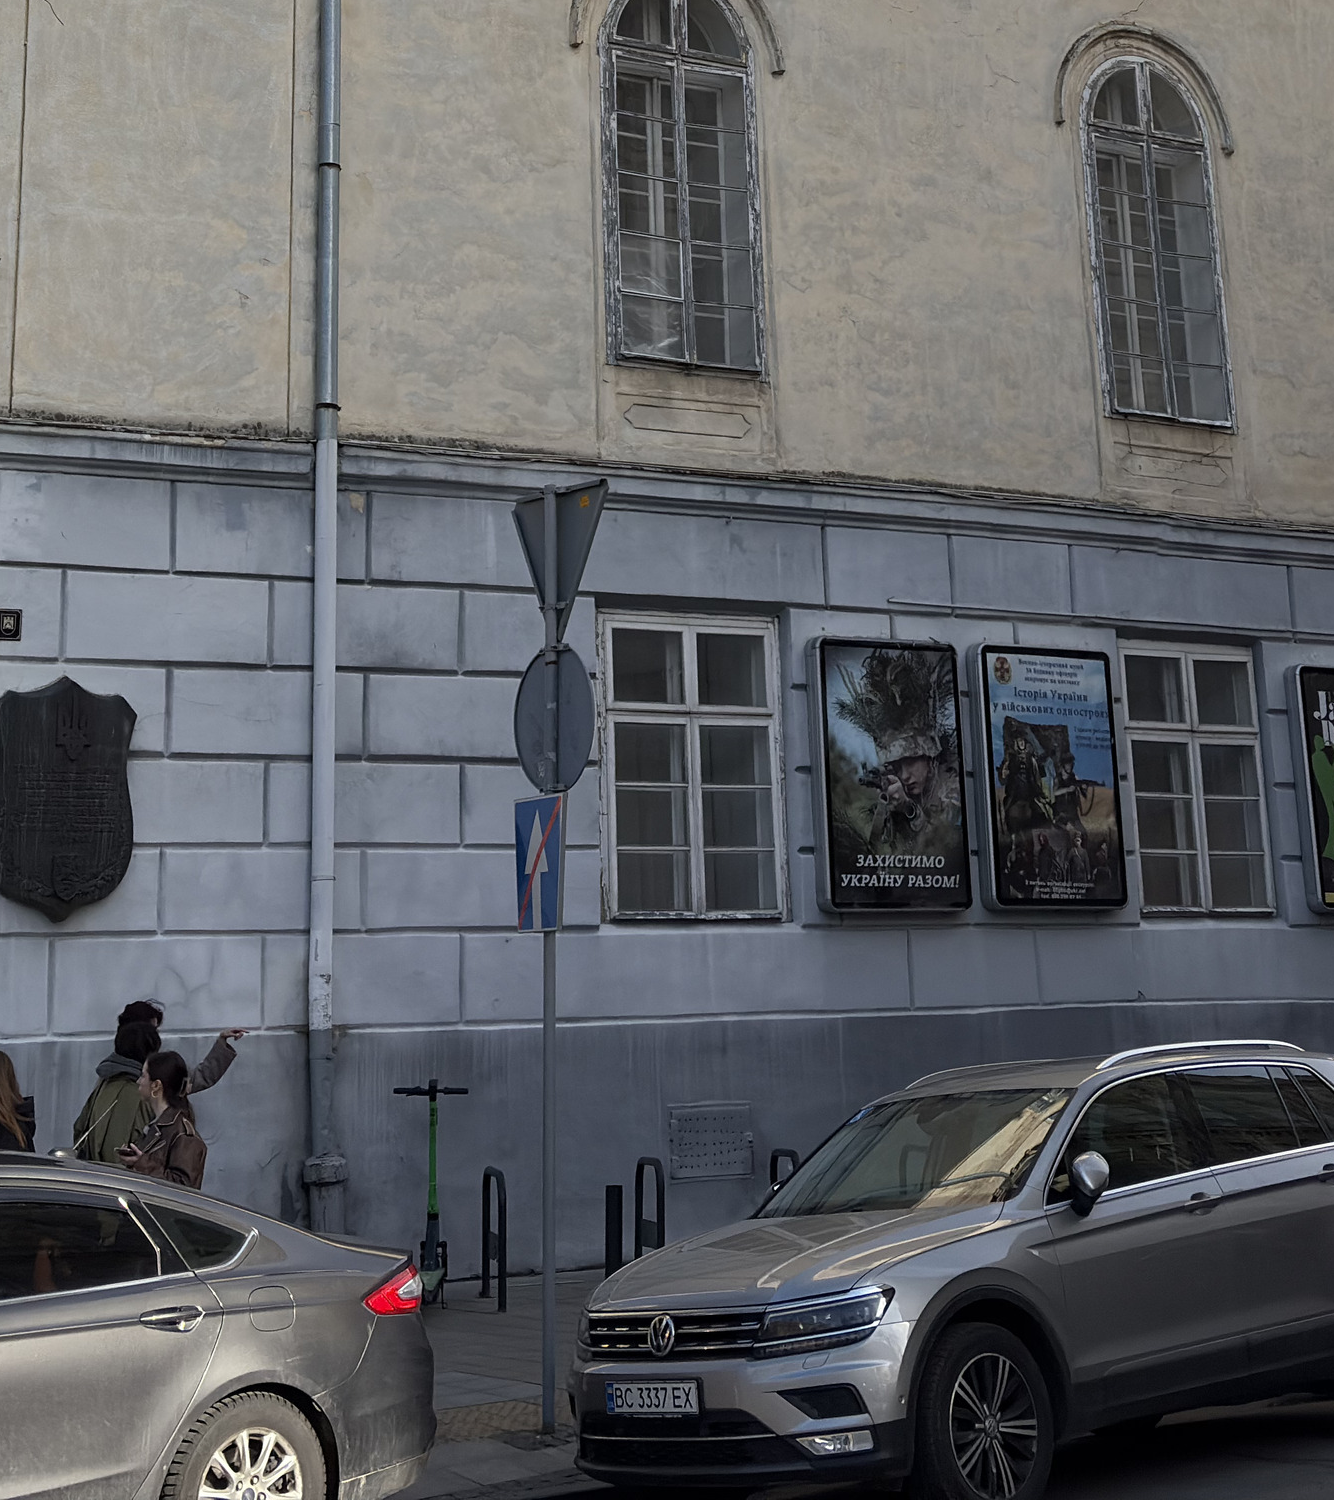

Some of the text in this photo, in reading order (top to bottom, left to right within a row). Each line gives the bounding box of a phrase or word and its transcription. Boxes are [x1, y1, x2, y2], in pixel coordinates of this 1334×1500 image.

[1014, 686, 1088, 703] Історія України
[1002, 701, 1054, 714] військових
[856, 854, 945, 869] ЗАХИСТИМО
[840, 871, 960, 888] УКРАЇНУ РАЗОМ!
[614, 1386, 693, 1409] BC 3337 EX
